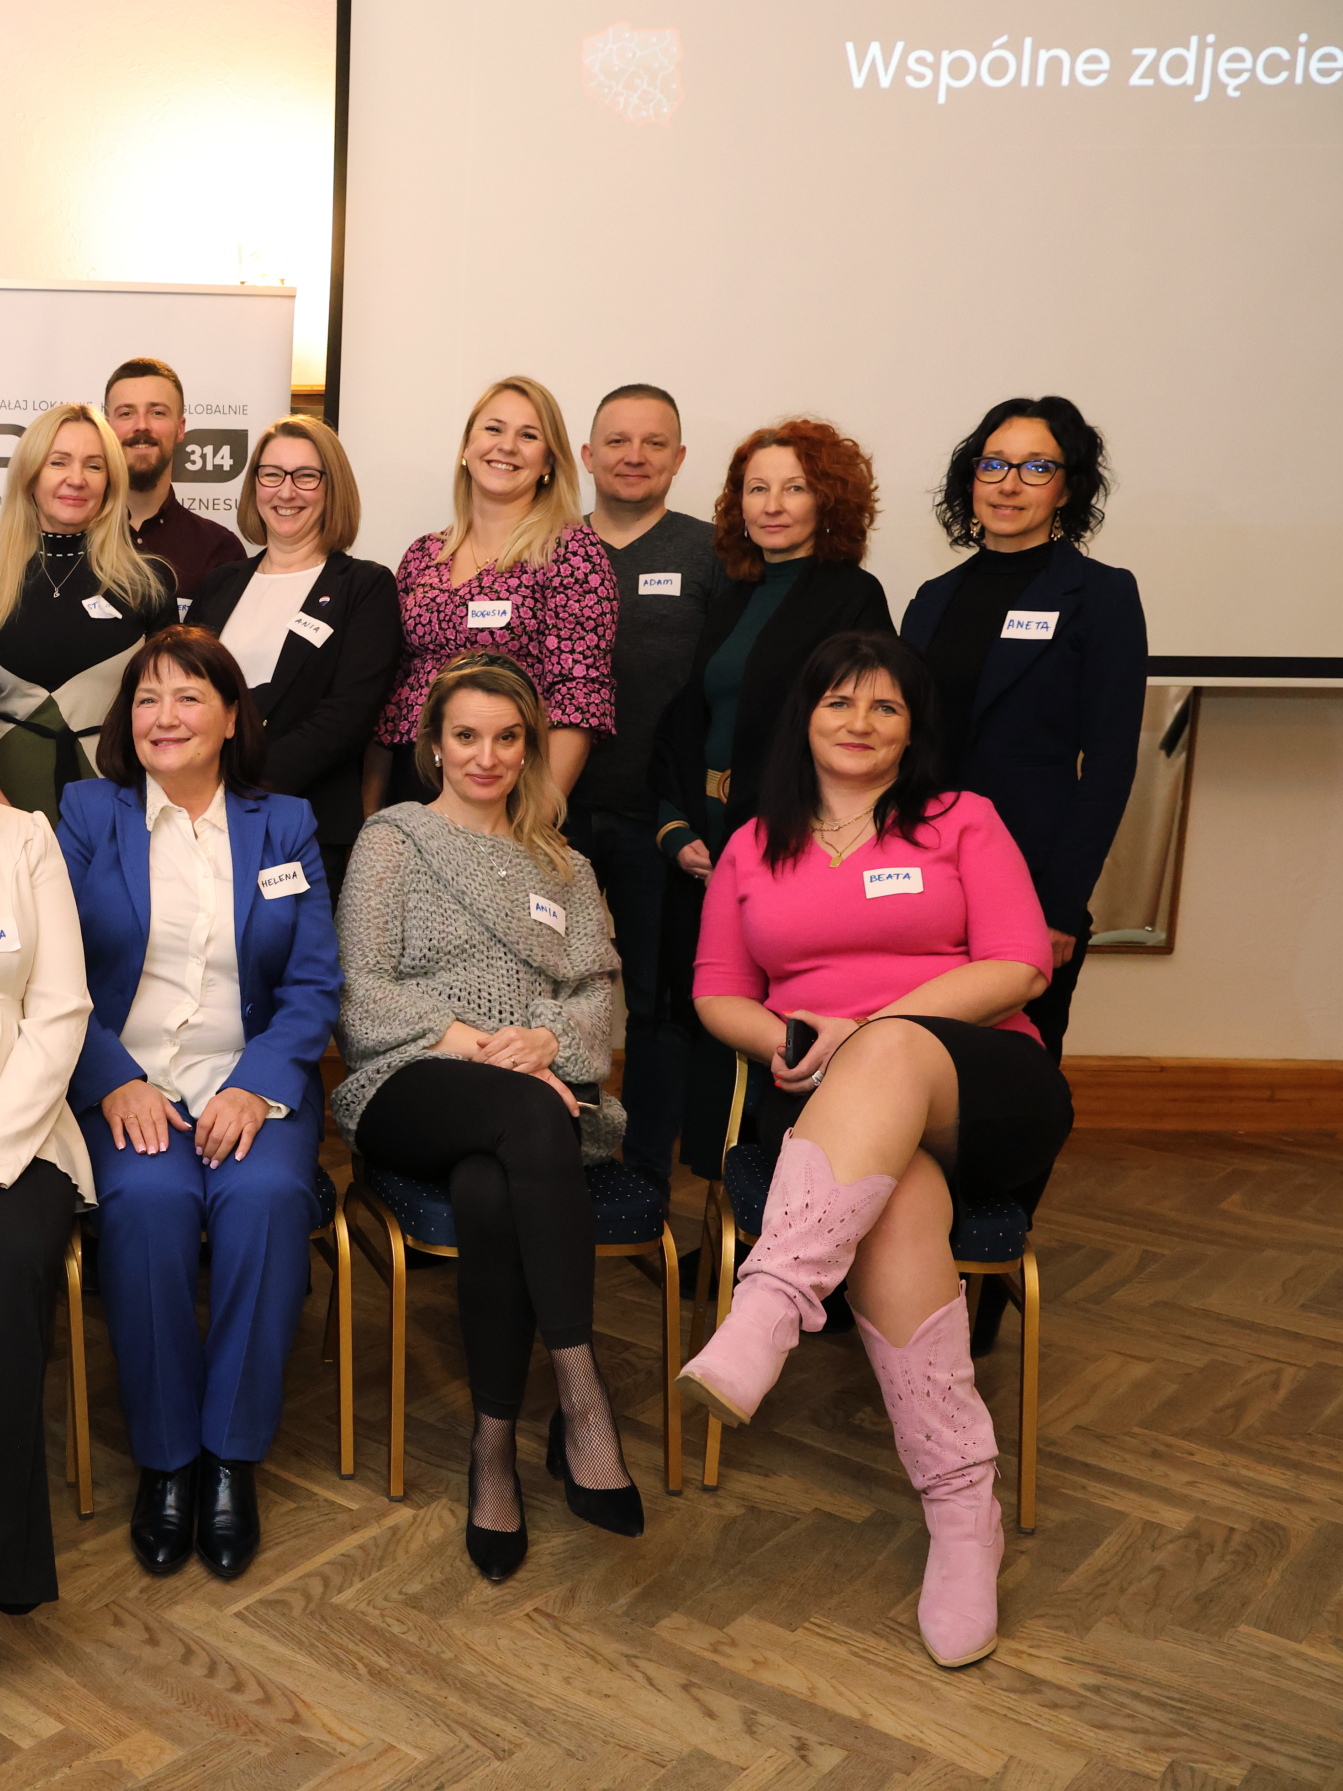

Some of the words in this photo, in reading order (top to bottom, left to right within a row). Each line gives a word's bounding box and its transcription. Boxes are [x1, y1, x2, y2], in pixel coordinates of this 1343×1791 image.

[844, 34, 1111, 104] Wspólne
[1128, 33, 1343, 102] zdjęcie
[184, 444, 234, 471] 314
[643, 579, 673, 587] ADAM
[295, 618, 321, 633] ANIA
[1006, 619, 1051, 632] ANETA
[261, 871, 298, 888] HELENA
[869, 872, 912, 883] BEATA
